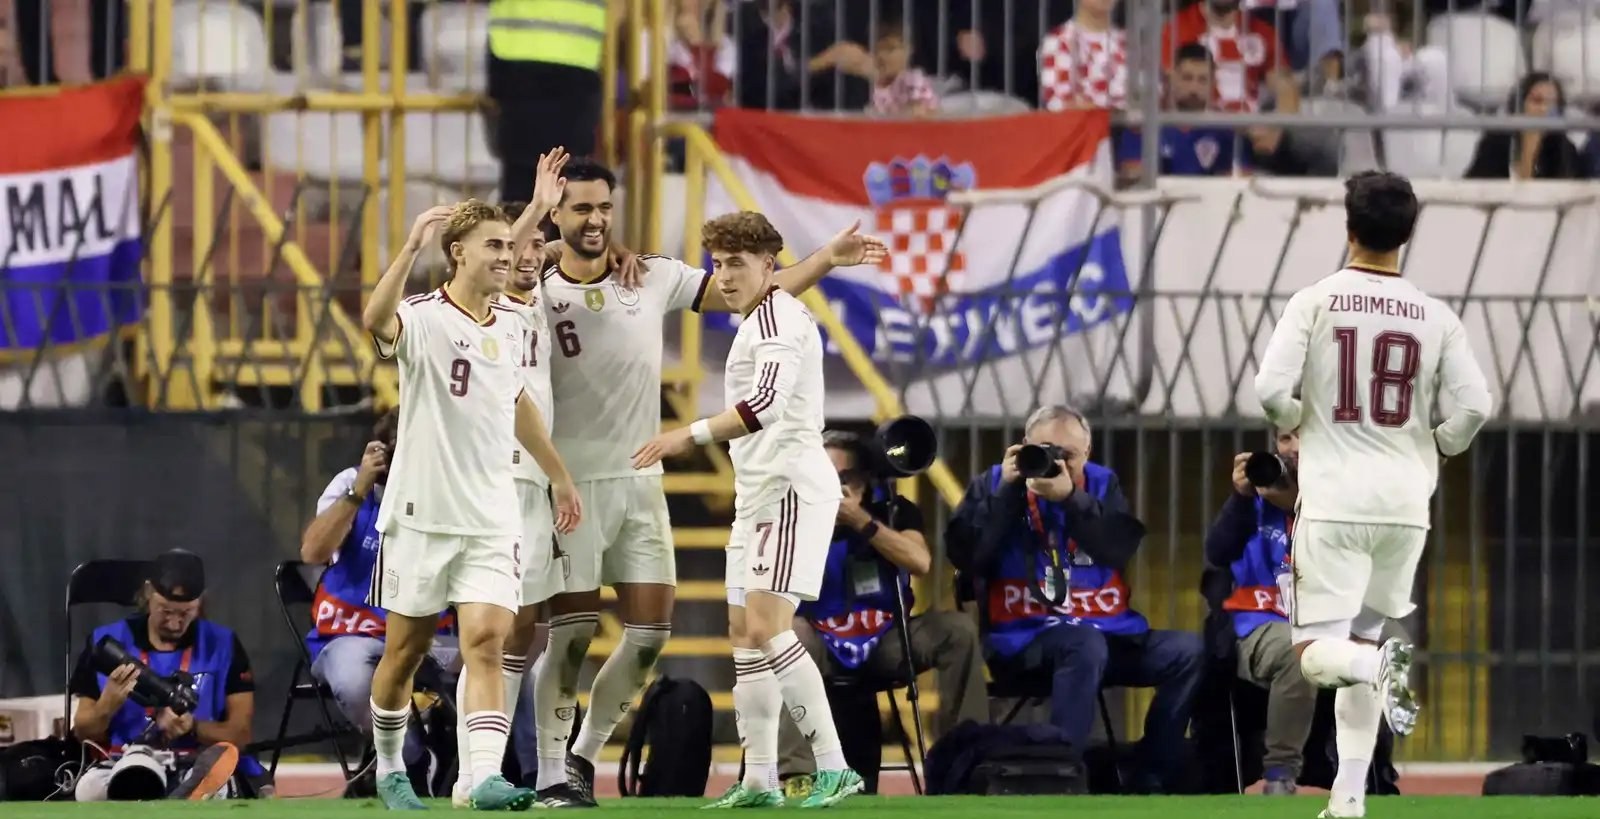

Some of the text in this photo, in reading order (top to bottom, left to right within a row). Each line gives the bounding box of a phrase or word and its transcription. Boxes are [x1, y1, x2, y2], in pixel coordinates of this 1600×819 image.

[1329, 294, 1426, 321] ZUBIMENDI
[555, 320, 581, 358] 6
[450, 358, 471, 397] 9
[1332, 326, 1422, 428] 18
[756, 522, 773, 557] 7
[1257, 525, 1288, 546] EFA
